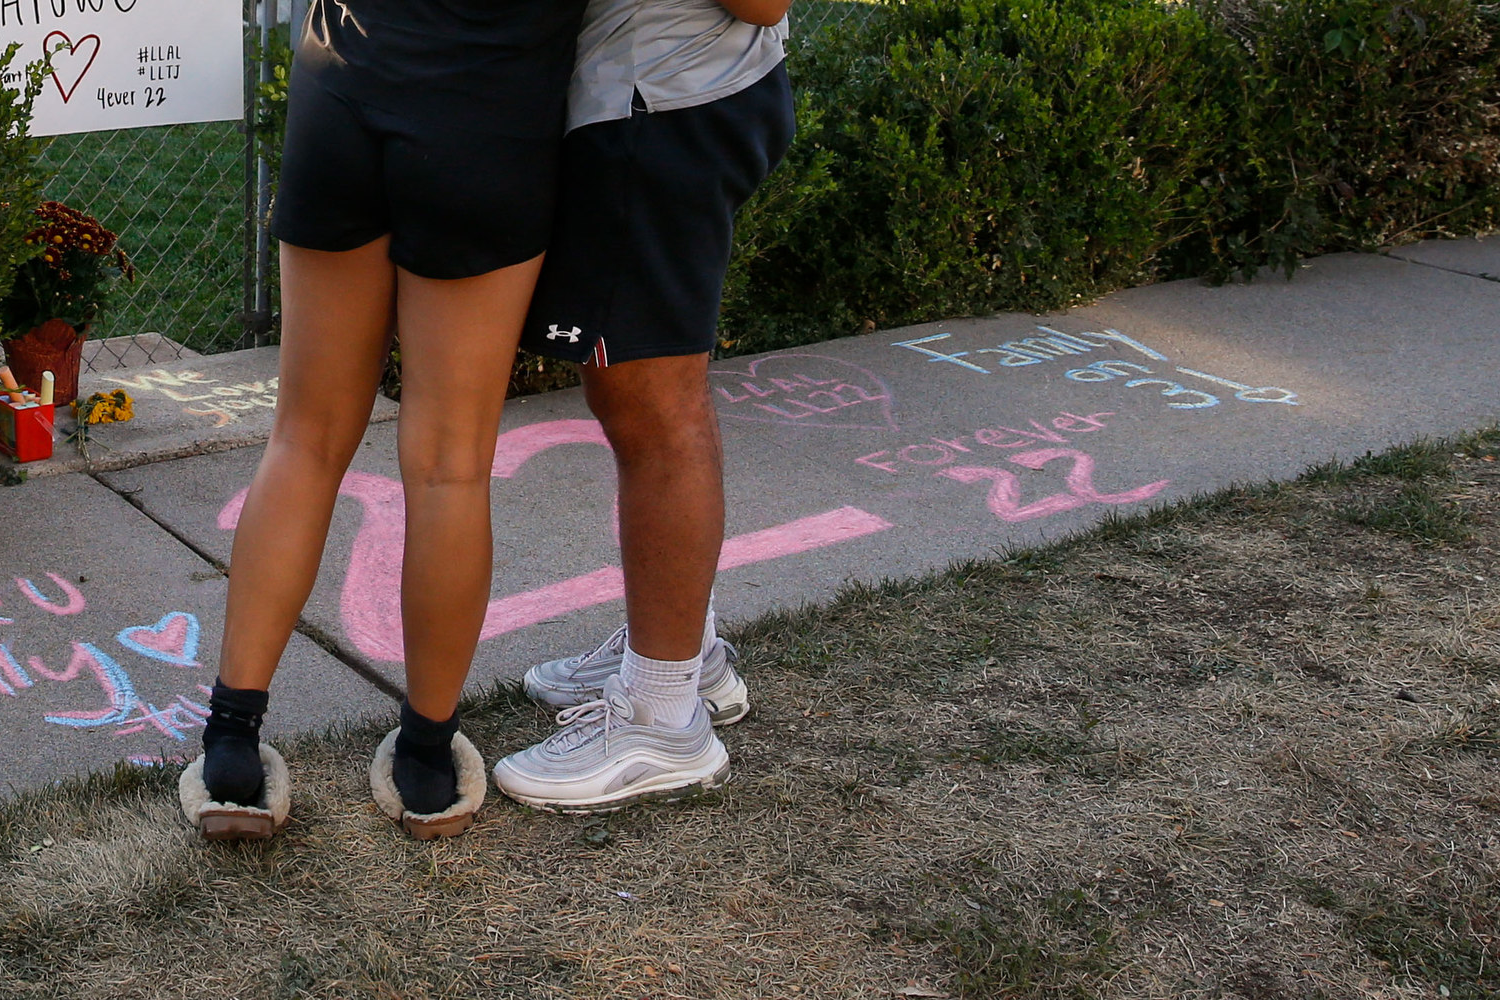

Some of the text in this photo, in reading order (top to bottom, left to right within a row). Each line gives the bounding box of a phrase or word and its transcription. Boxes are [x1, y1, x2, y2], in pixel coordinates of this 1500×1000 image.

[137, 46, 181, 63] #LLAL
[137, 64, 180, 81] #LLTJ
[97, 87, 167, 109] 4ever 22
[890, 326, 1168, 374] Family
[933, 448, 1171, 522] 22
[15, 571, 86, 616] U
